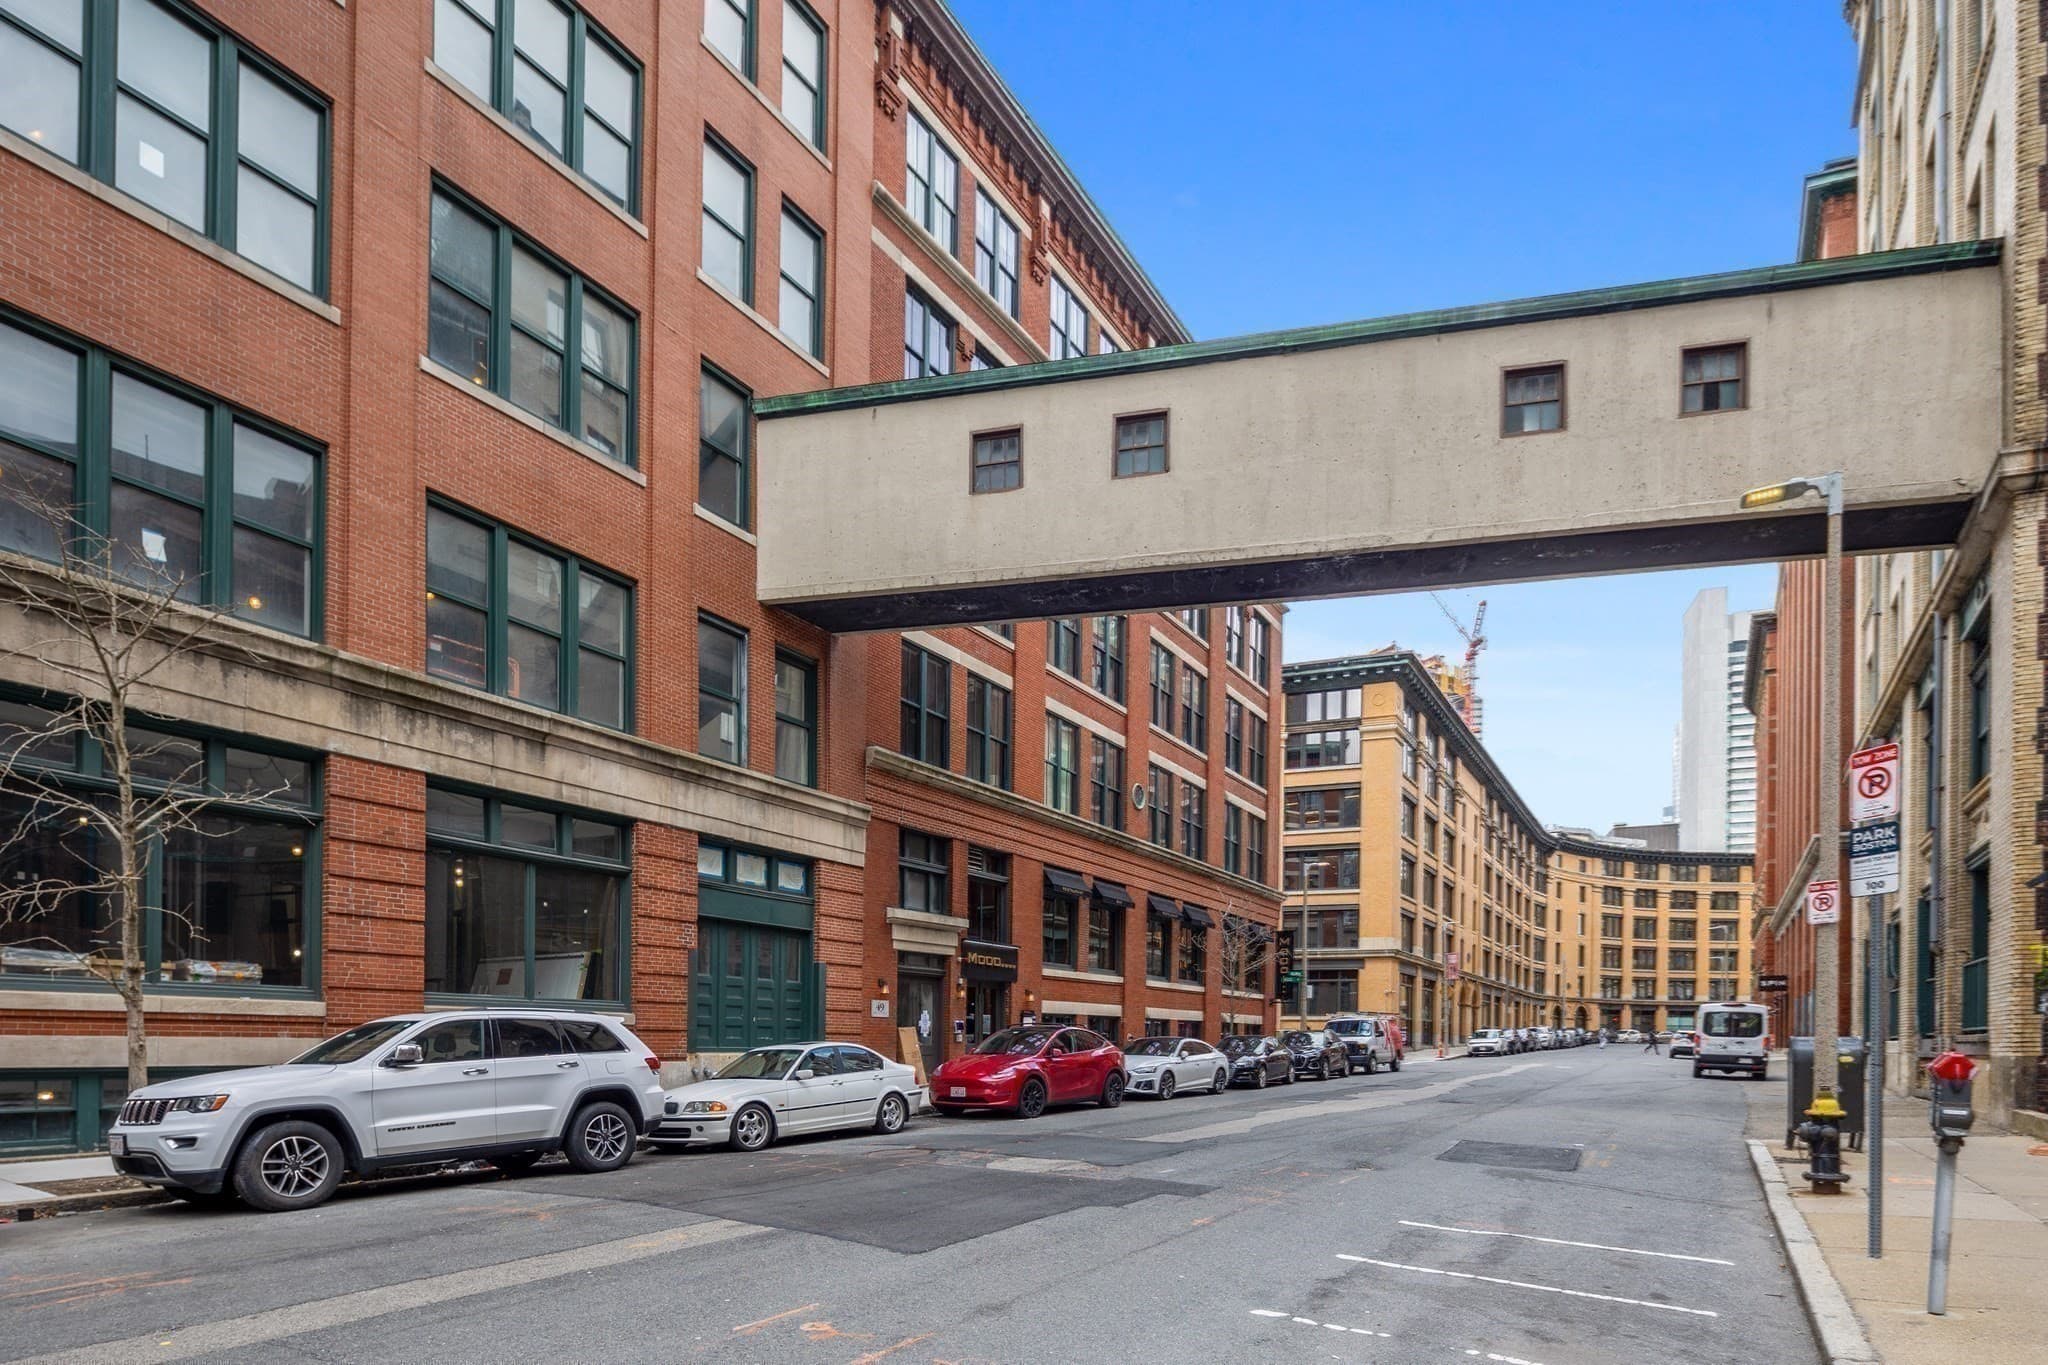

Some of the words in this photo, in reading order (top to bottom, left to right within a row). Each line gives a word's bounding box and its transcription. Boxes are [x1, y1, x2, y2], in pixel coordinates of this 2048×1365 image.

[1852, 826, 1897, 843] PARK
[1852, 837, 1897, 852] BOSTON
[1865, 881, 1885, 890] 100
[875, 1002, 885, 1012] 49
